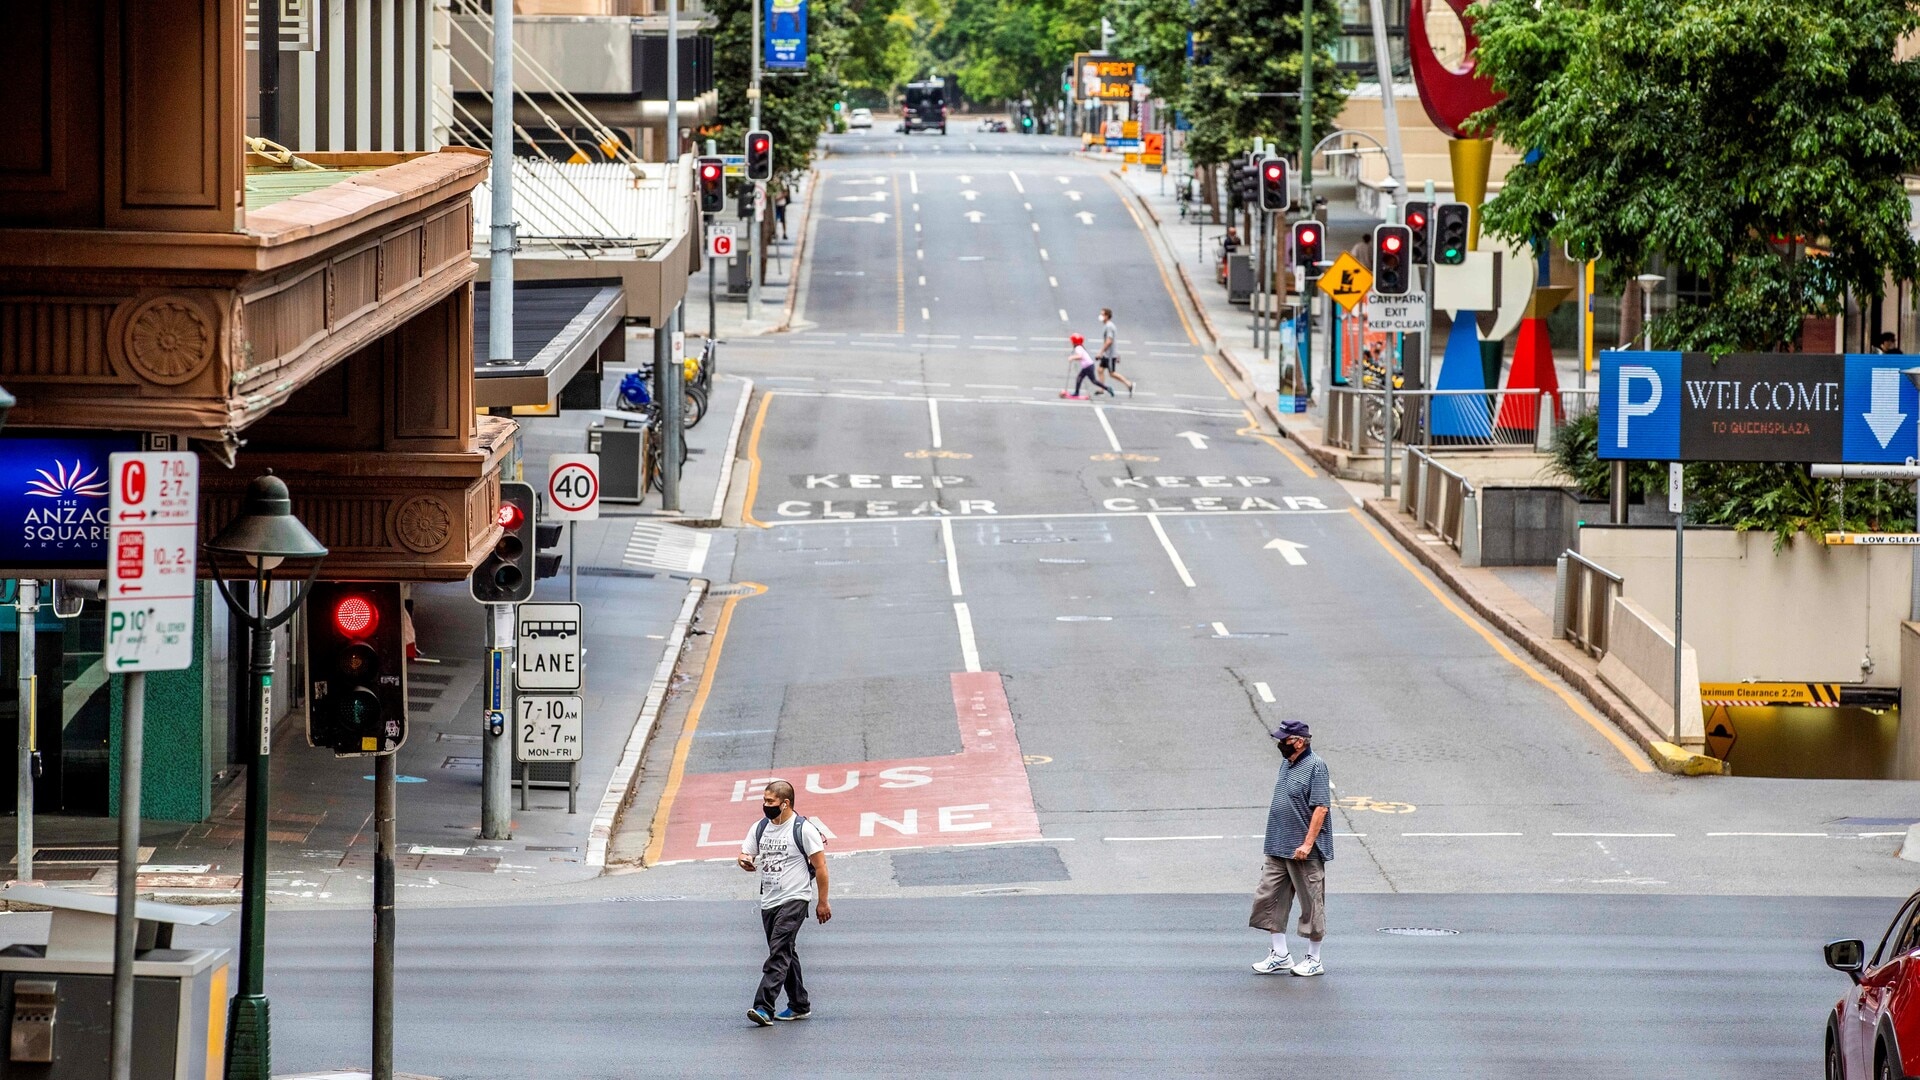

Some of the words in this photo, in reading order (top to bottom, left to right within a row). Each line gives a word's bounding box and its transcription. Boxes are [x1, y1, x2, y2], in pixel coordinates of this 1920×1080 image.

[1086, 61, 1135, 76] XPECT
[1368, 295, 1392, 305] CAR
[1394, 295, 1425, 304] PARK
[1384, 307, 1408, 317] EXIT
[1368, 320, 1393, 329] KEEP
[1394, 320, 1426, 329] CLEAR
[1685, 380, 1840, 412] WELCOME
[1617, 365, 1663, 448] P
[1711, 421, 1727, 434] TO
[1730, 421, 1811, 435] QUEENSPLAZA
[1860, 469, 1889, 477] Caution
[1890, 470, 1914, 478] Height
[555, 475, 590, 498] 40
[806, 474, 966, 489] KEEP
[1113, 475, 1271, 489] KEEP
[777, 500, 998, 519] CLEAR
[1103, 496, 1328, 512] CLEAR
[24, 525, 109, 541] SQUARE
[110, 611, 126, 644] P
[523, 654, 575, 672] LANE
[1700, 687, 1735, 697] aximum
[1736, 688, 1780, 698] Clearance
[1782, 688, 1804, 698] 2.2m
[528, 748, 572, 757] MON-FRI
[730, 766, 932, 802] BUS
